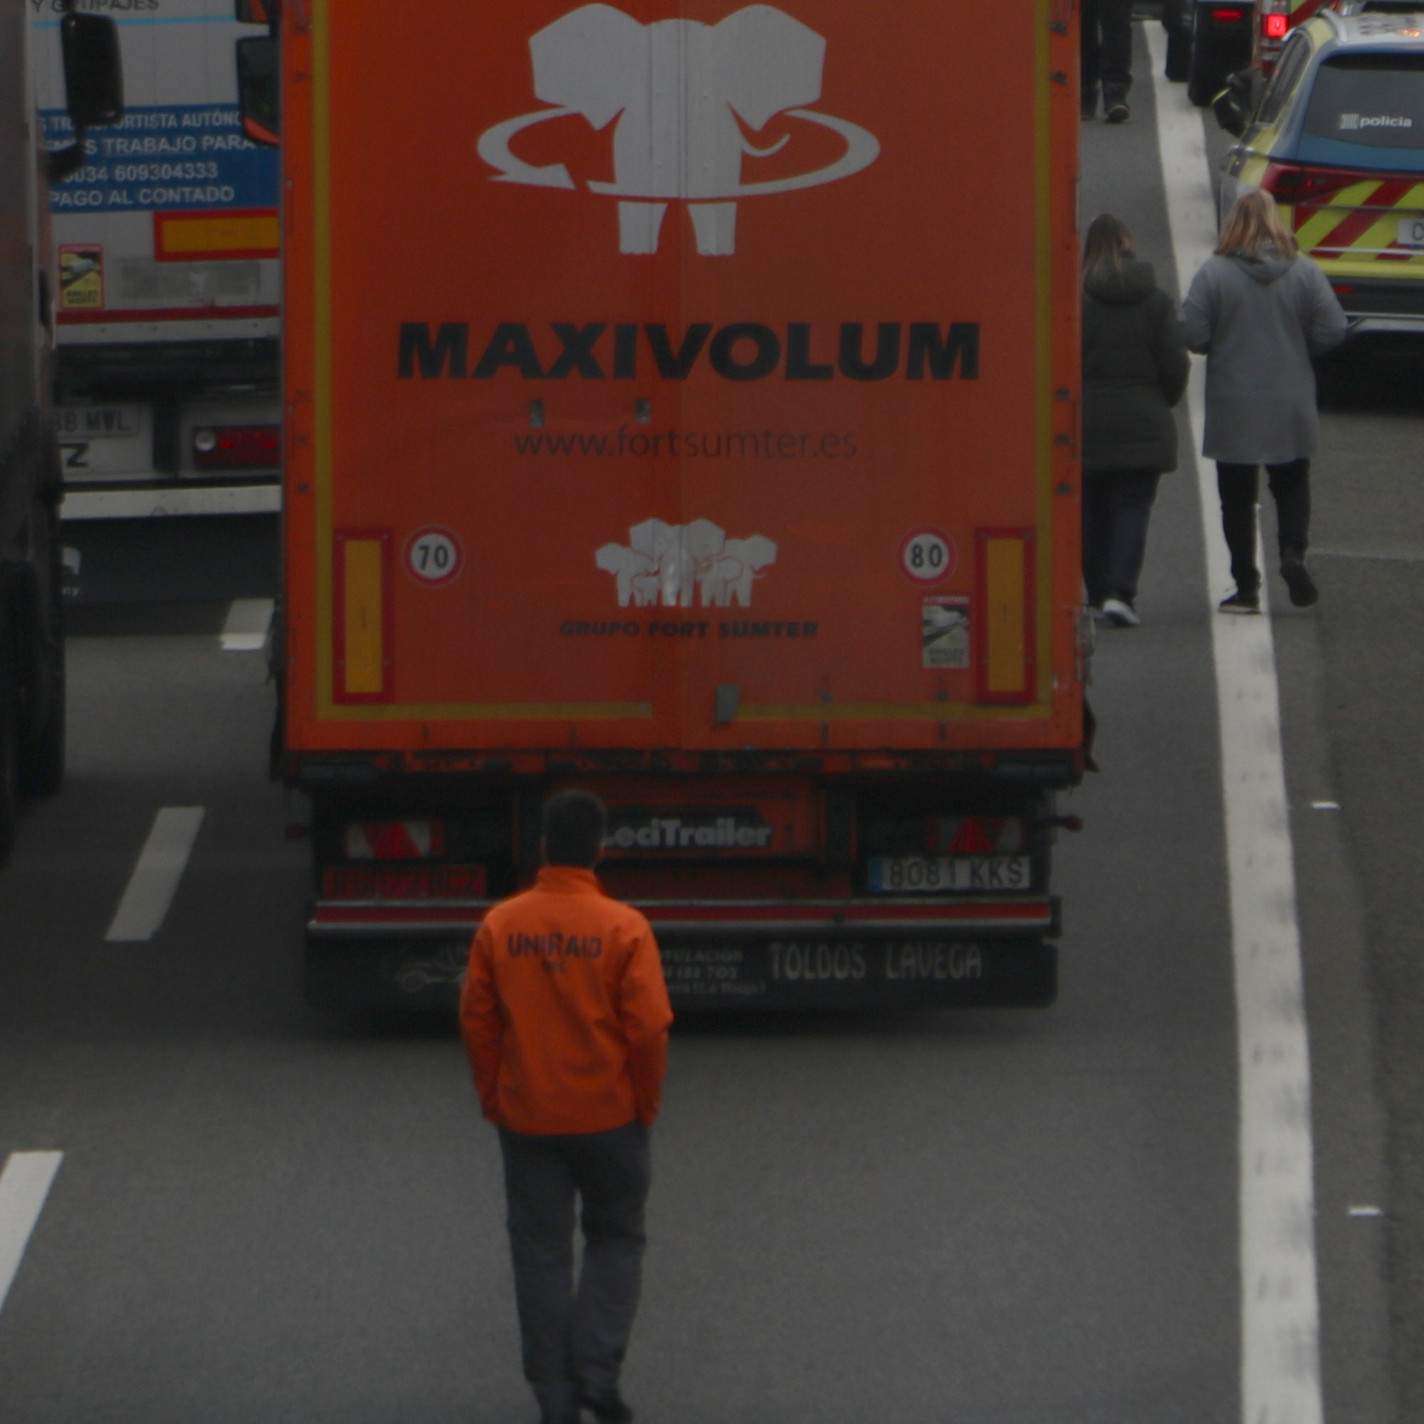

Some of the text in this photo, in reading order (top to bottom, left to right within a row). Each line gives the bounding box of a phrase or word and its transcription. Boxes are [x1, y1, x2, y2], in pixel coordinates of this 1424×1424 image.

[1360, 115, 1412, 129] policia
[104, 136, 197, 155] TRABAJO
[201, 135, 256, 151] PARA
[114, 162, 219, 181] 609304333
[109, 189, 133, 205] AL
[138, 186, 235, 204] CONTADO
[397, 322, 980, 380] MAXIVOLUM
[514, 426, 858, 459] www.fortsumter.es
[419, 542, 449, 570] 70
[911, 542, 943, 569] 80
[559, 619, 819, 639] GRUPO FORT SUMTER
[889, 858, 1024, 886] 8081 KKS
[507, 932, 602, 960] UNIRAID
[770, 942, 984, 981] TOLDOS LAVEGA
